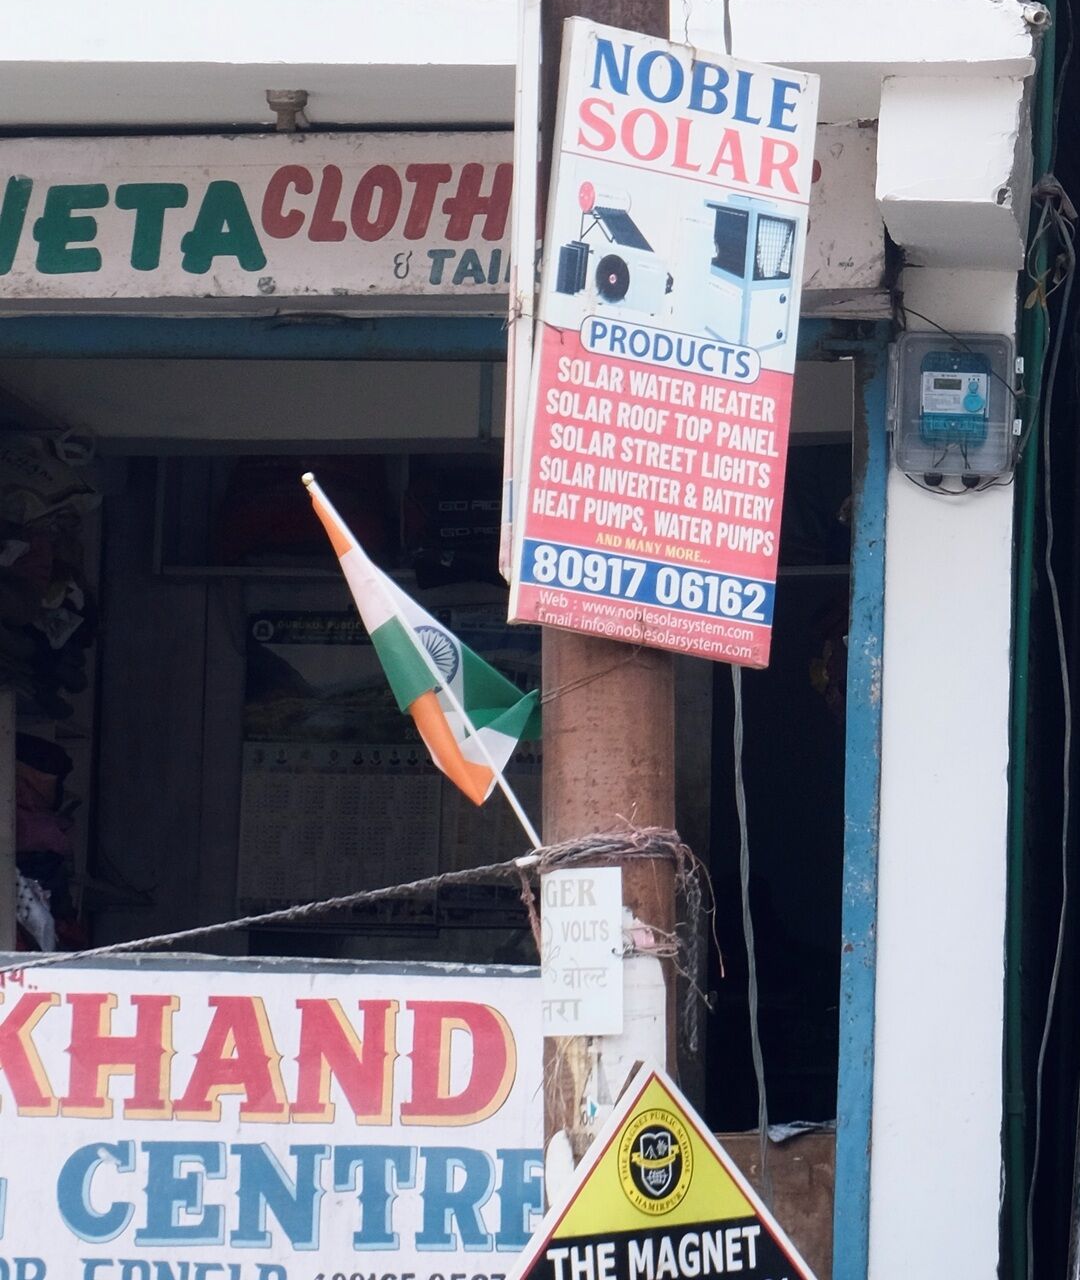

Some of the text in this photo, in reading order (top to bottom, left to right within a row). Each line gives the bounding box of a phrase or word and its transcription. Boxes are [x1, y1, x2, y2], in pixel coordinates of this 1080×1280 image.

[591, 38, 801, 133] NOBLE
[577, 97, 800, 194] SOLAR
[426, 249, 513, 286] TAI
[589, 320, 751, 379] PRODUCTS
[558, 357, 775, 423] SOLAR WATER HEATER
[546, 389, 779, 457] SOLAR ROOF TOP PANEL
[550, 423, 770, 488] SOLAR STREET LIGHTS
[539, 456, 774, 523] SOLAR INVERTER & BATTERY
[532, 488, 774, 557] HEAT PUMPS, WATER PUMPS
[595, 532, 622, 547] AND
[625, 538, 661, 554] MANY
[533, 544, 766, 622] 80917 06162
[538, 610, 571, 628] Email
[581, 617, 752, 659] info@noblesolarsystem.com
[539, 591, 569, 609] Web
[582, 601, 754, 641] www.noblesolarsystem.com
[542, 878, 597, 908] GER
[561, 919, 609, 943] VOLTS
[56, 1140, 544, 1252] CENTRE
[546, 1225, 761, 1280] THE MAGNET
